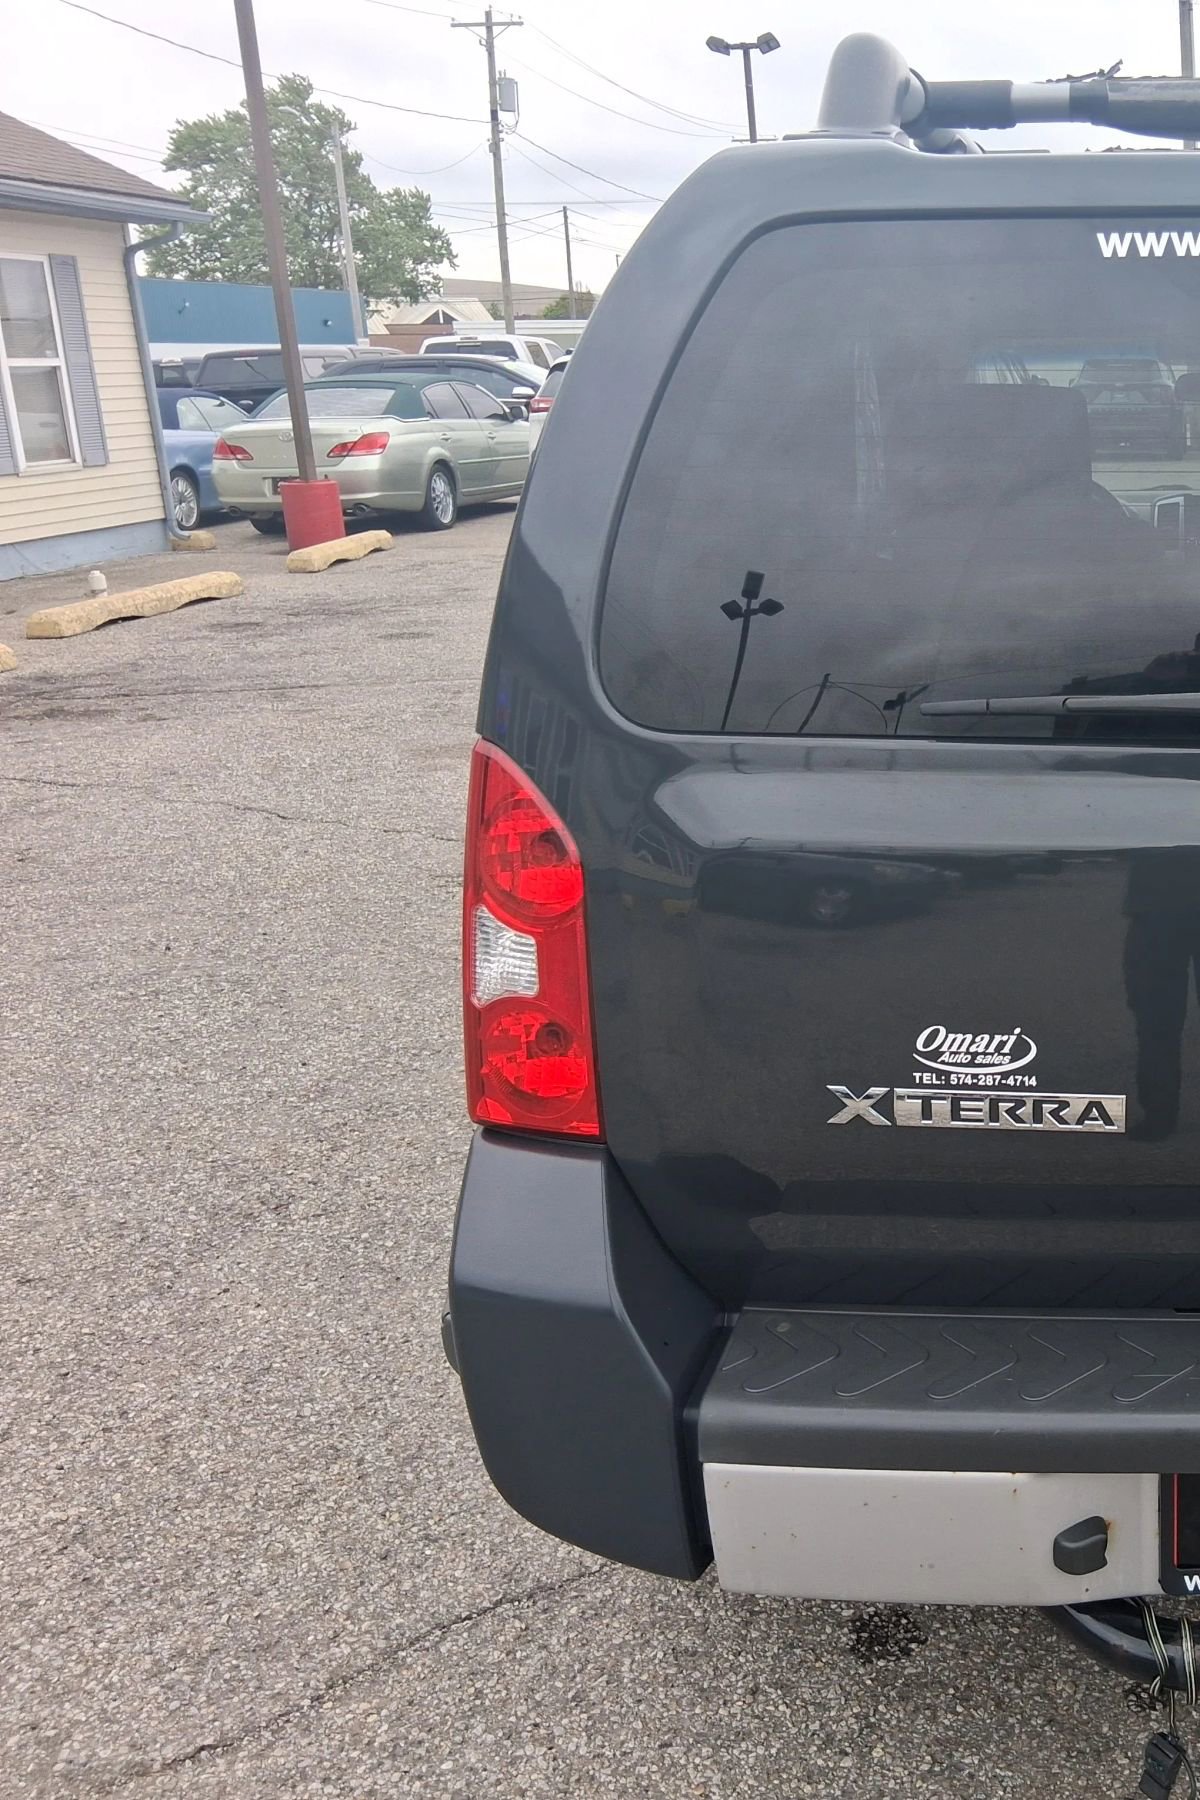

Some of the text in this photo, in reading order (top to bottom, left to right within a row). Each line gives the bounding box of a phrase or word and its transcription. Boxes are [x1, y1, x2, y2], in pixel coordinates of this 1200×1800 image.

[915, 1025, 1022, 1055] Omari
[937, 1051, 1012, 1065] Auto sales
[913, 1072, 1038, 1087] TEL: 574-287-4714
